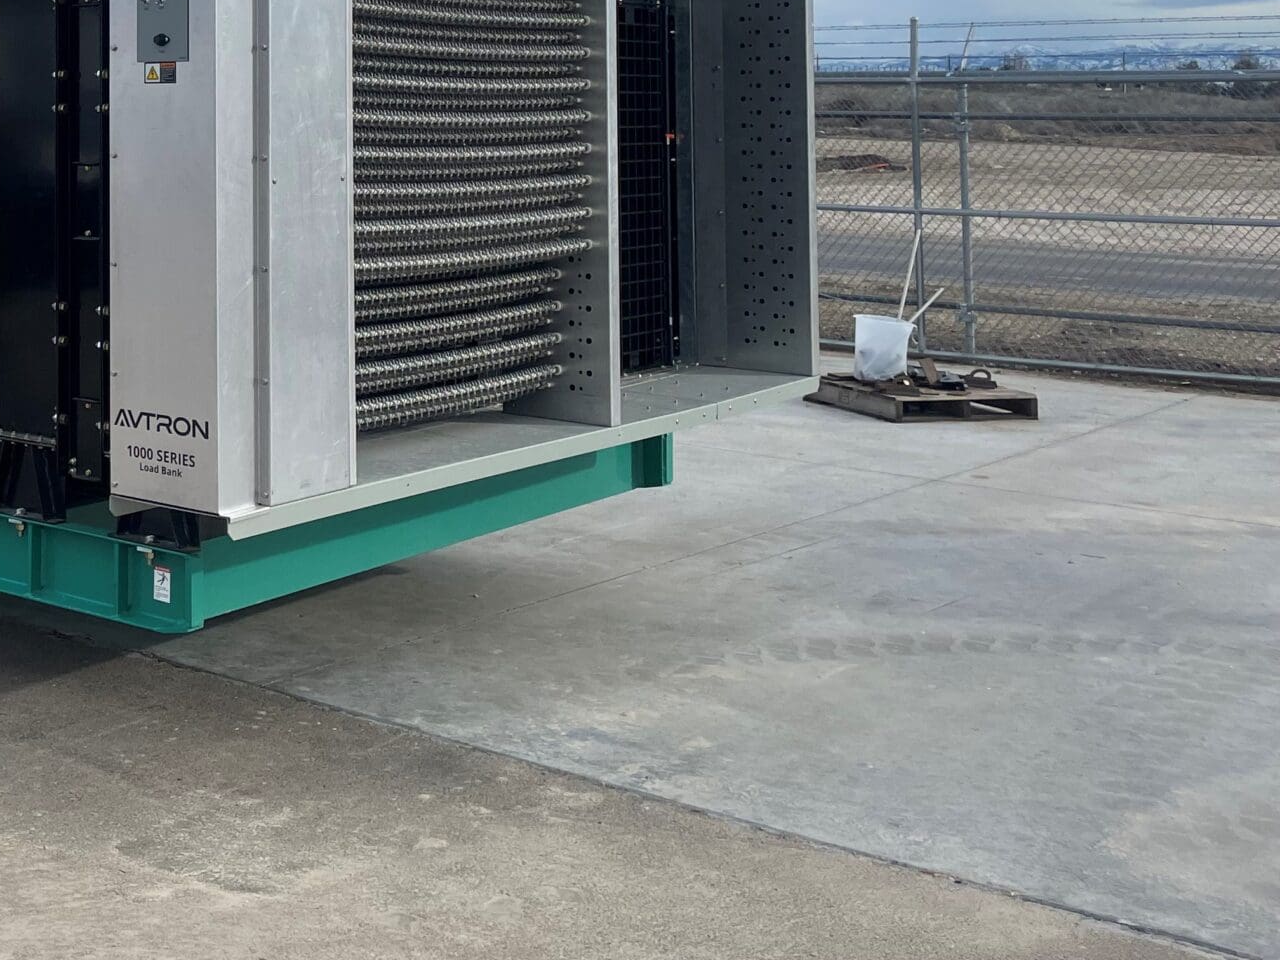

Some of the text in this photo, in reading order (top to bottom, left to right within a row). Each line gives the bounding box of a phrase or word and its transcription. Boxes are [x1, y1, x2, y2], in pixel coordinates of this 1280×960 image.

[114, 408, 209, 440] AVTRON
[127, 445, 196, 468] 1000 SERIES
[139, 462, 183, 478] Load Bank
